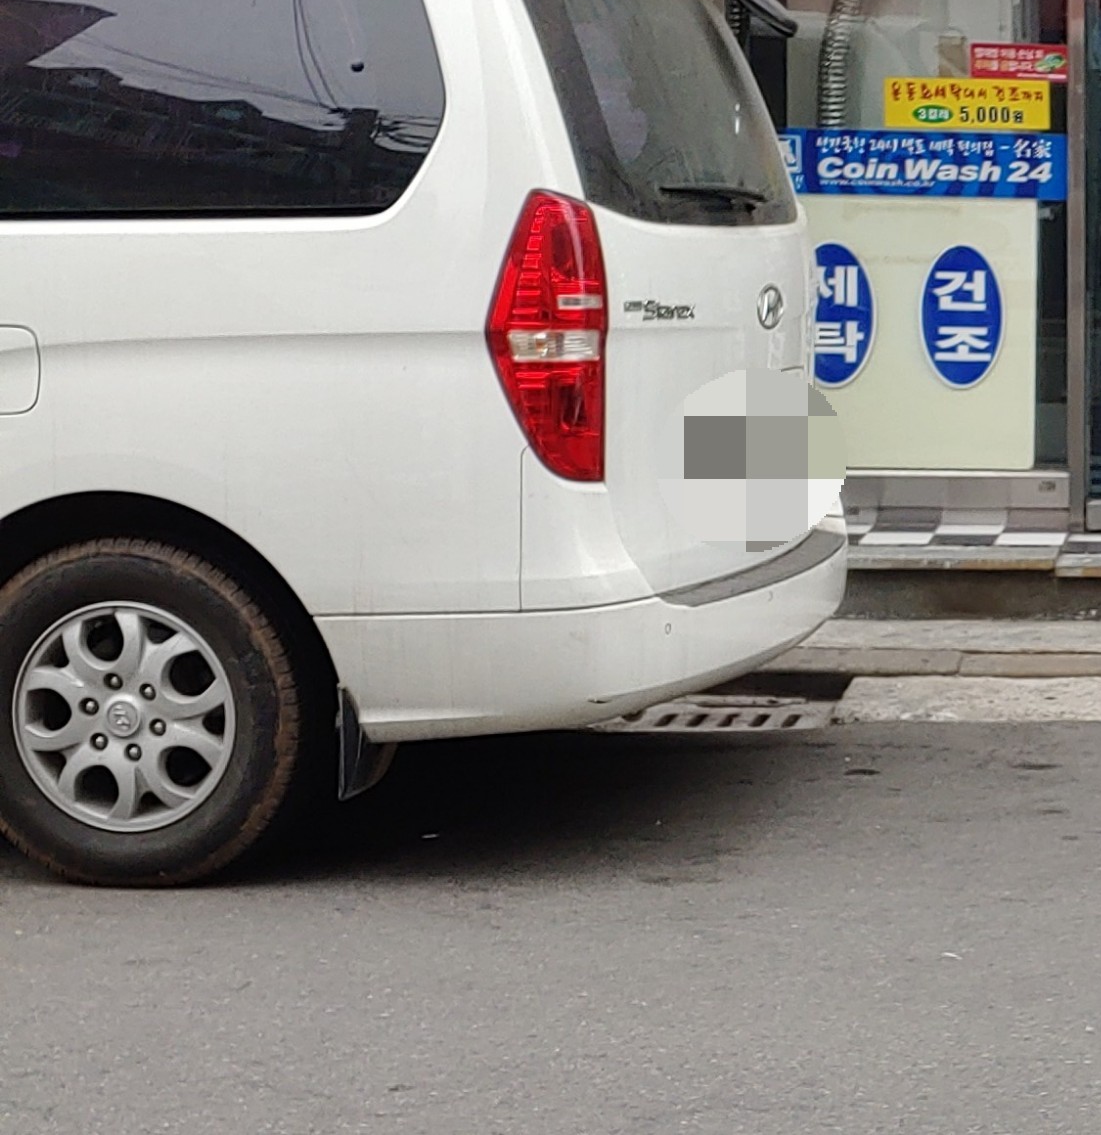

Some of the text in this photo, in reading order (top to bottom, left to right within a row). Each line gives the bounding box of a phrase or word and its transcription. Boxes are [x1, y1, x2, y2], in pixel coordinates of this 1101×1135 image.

[817, 156, 1053, 183] Coin Wash 24
[932, 269, 993, 362] 건조
